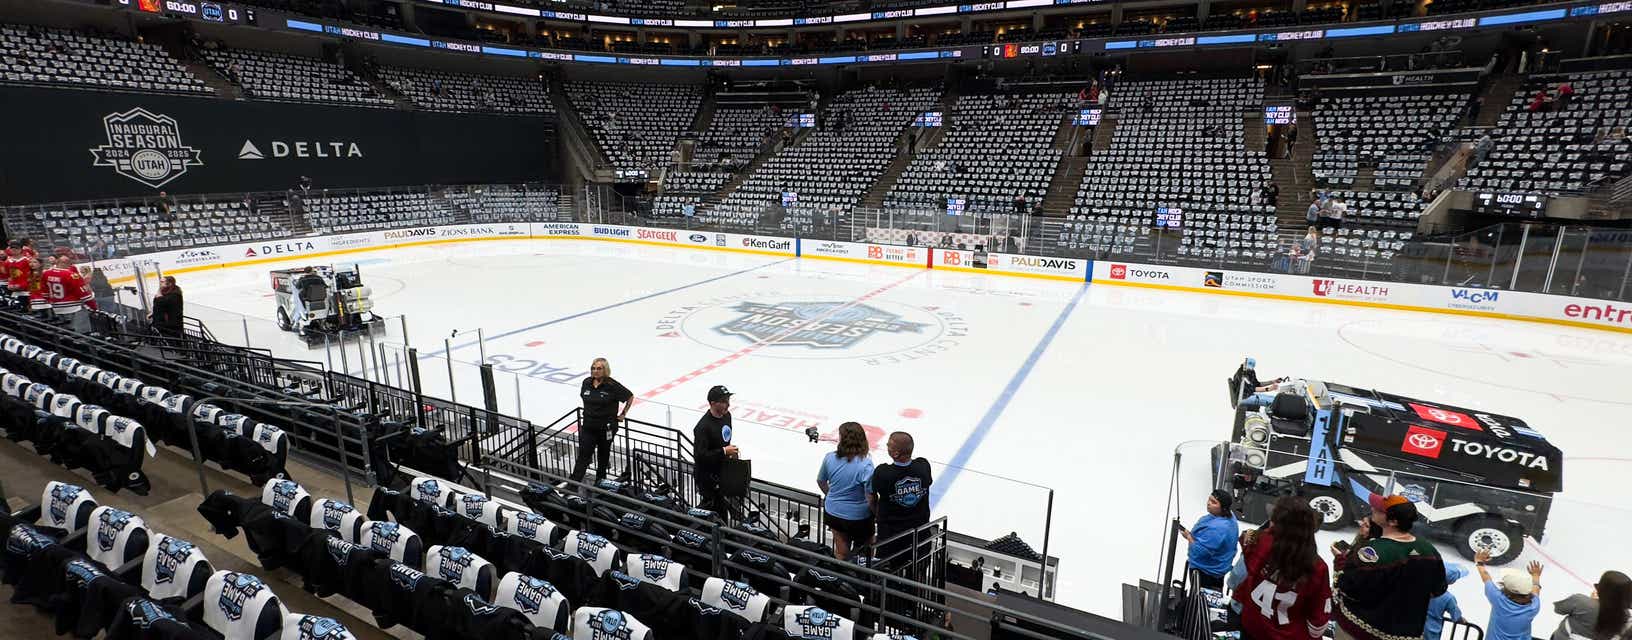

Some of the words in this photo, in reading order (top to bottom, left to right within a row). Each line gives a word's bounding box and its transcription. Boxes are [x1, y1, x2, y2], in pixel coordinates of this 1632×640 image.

[166, 1, 196, 13] 60:00
[885, 9, 901, 18] HOCKEY
[901, 8, 913, 17] CLUB
[972, 2, 991, 11] HOCKEY
[991, 1, 1005, 9] CLUB
[228, 9, 238, 20] 0
[325, 25, 342, 35] UTAH
[341, 28, 364, 39] HOCKEY
[364, 31, 379, 41] CLUB
[994, 47, 1000, 56] 0
[1060, 43, 1067, 53] 0
[110, 124, 175, 136] INAUGURAL
[112, 134, 178, 149] SEASON
[105, 150, 130, 158] 2024
[167, 150, 190, 158] 2025
[271, 141, 363, 158] DELTA
[137, 159, 165, 171] UTAH
[440, 228, 468, 237] ZIONS
[470, 227, 494, 235] BANK
[636, 228, 678, 242] SEATGEEK
[262, 241, 314, 256] DELTA
[750, 237, 769, 249] Ken
[768, 239, 790, 251] Garff
[1129, 268, 1169, 280] TOYOTA
[47, 281, 65, 300] 19
[1337, 283, 1389, 297] HEALTH
[1313, 415, 1331, 480] UTAH
[1451, 438, 1549, 471] TOYOTA
[897, 485, 920, 495] GAME
[466, 501, 484, 510] GAME
[326, 507, 343, 521] GAME
[518, 518, 538, 530] GAME
[327, 535, 353, 554] GAME
[373, 533, 392, 550] GAME
[578, 539, 600, 555] GAME
[158, 550, 178, 572] GAME
[441, 557, 464, 575] GAME
[644, 559, 668, 571] GAME
[222, 582, 247, 607] GAME
[518, 581, 543, 605] GAME
[723, 581, 751, 602] GAME
[1250, 579, 1298, 626] 47
[804, 625, 832, 637] GAME
